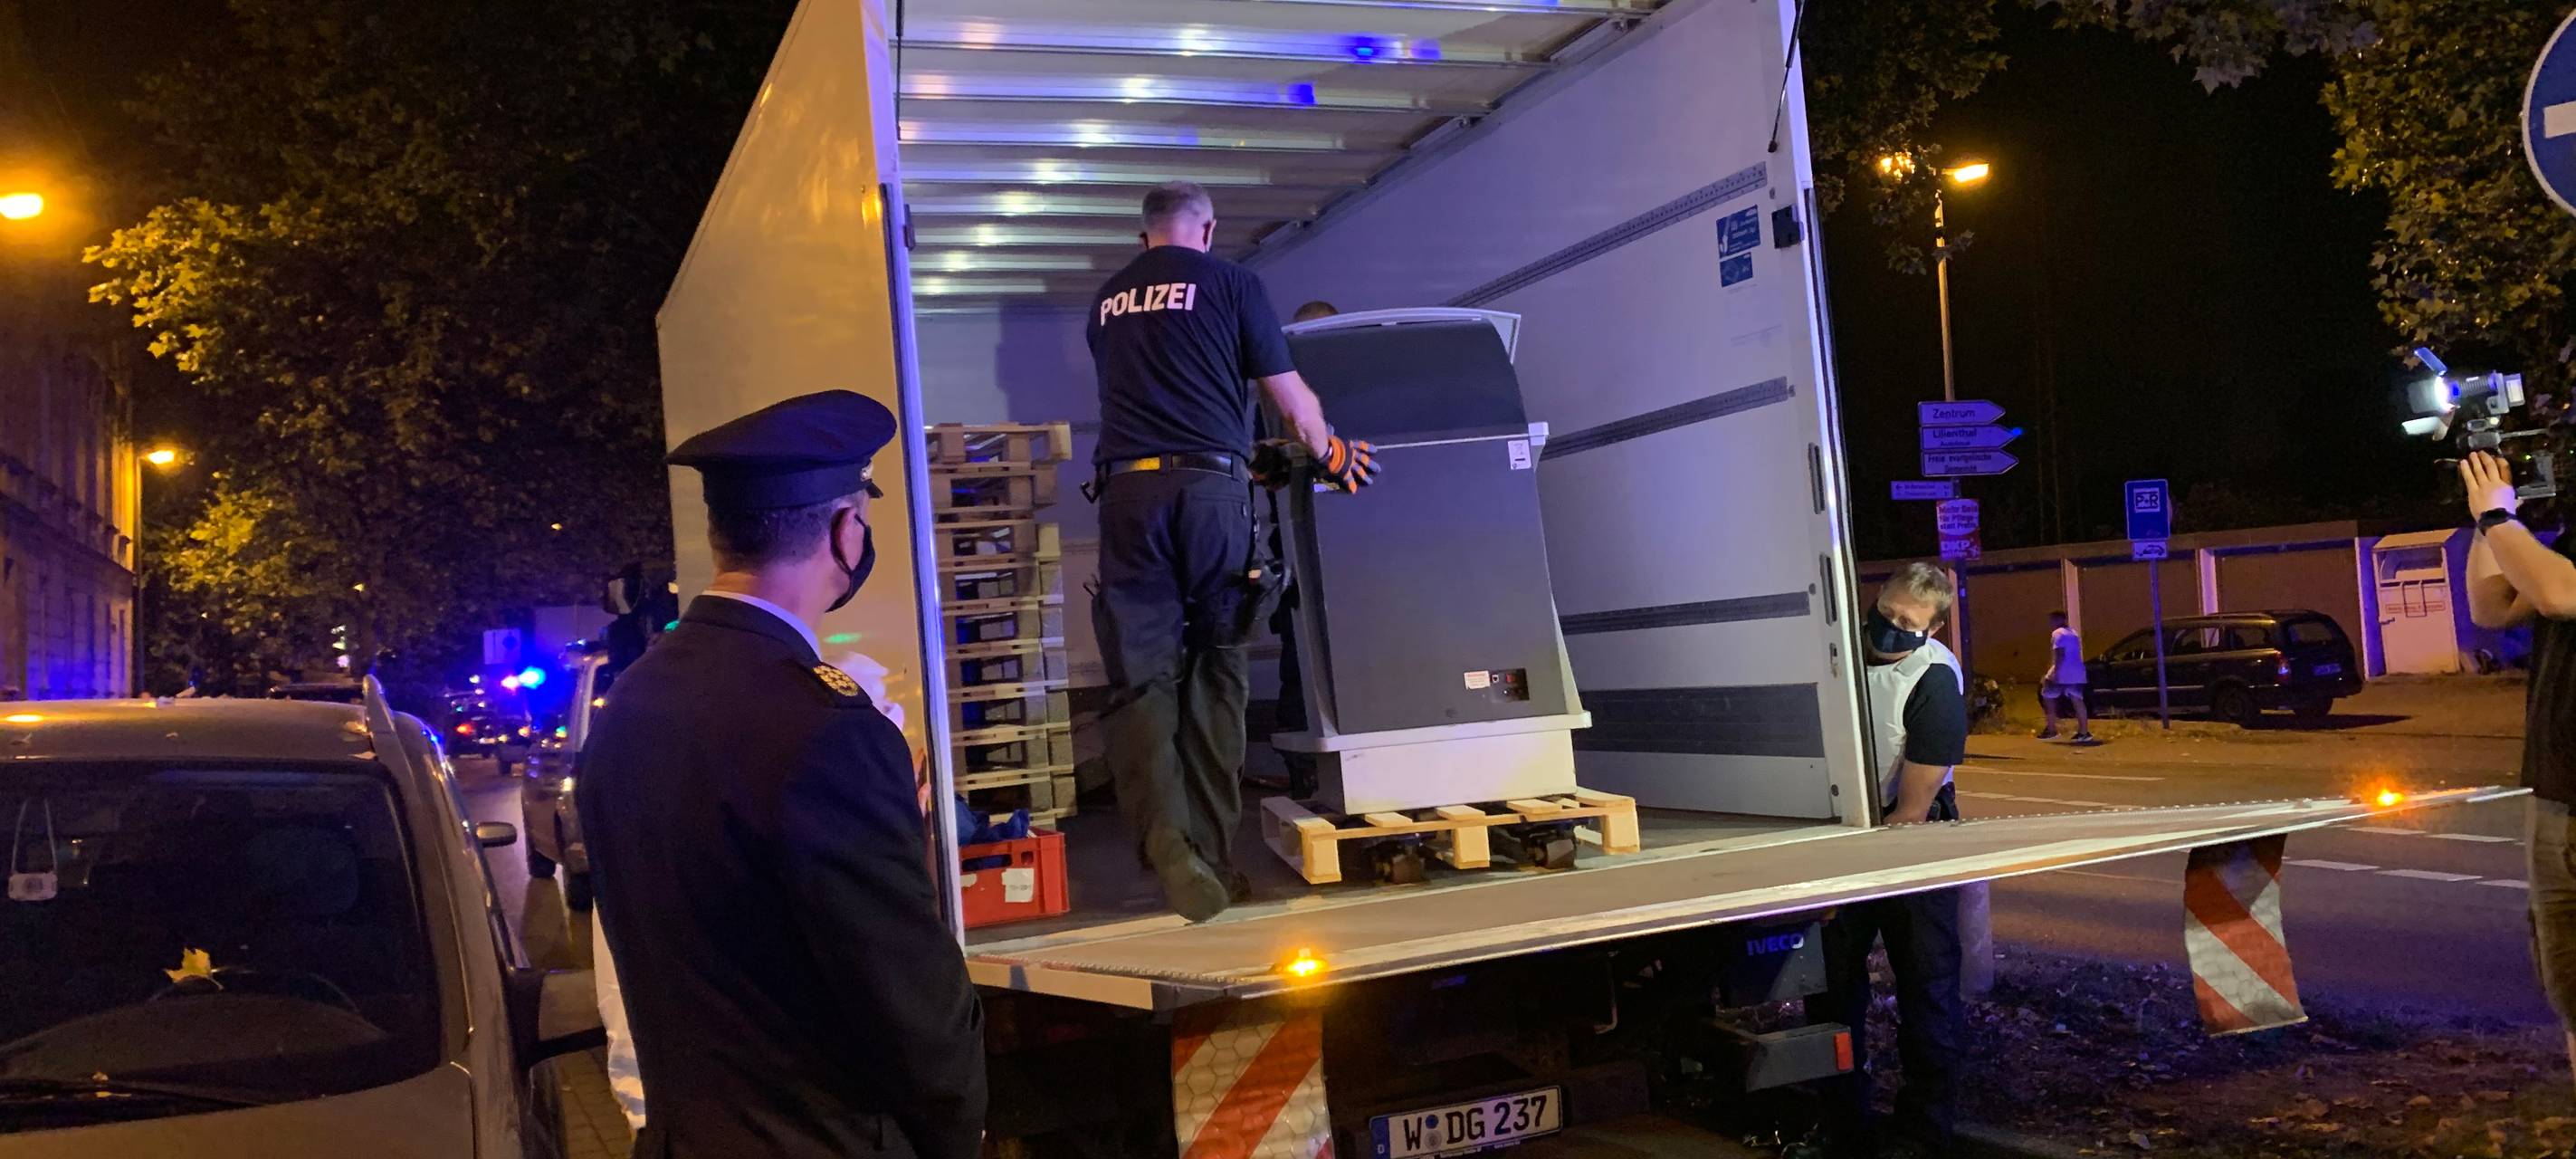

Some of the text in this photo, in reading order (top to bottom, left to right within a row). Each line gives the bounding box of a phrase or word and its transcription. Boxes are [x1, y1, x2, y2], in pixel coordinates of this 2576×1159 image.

[1100, 283, 1197, 326] POLIZEI
[1932, 408, 1976, 419] Zentrum
[1932, 426, 1977, 439] Lilienthal
[1746, 933, 1804, 956] IVECO
[1403, 1116, 1422, 1151] W
[1445, 1107, 1485, 1145] DG
[1493, 1095, 1548, 1135] 237
